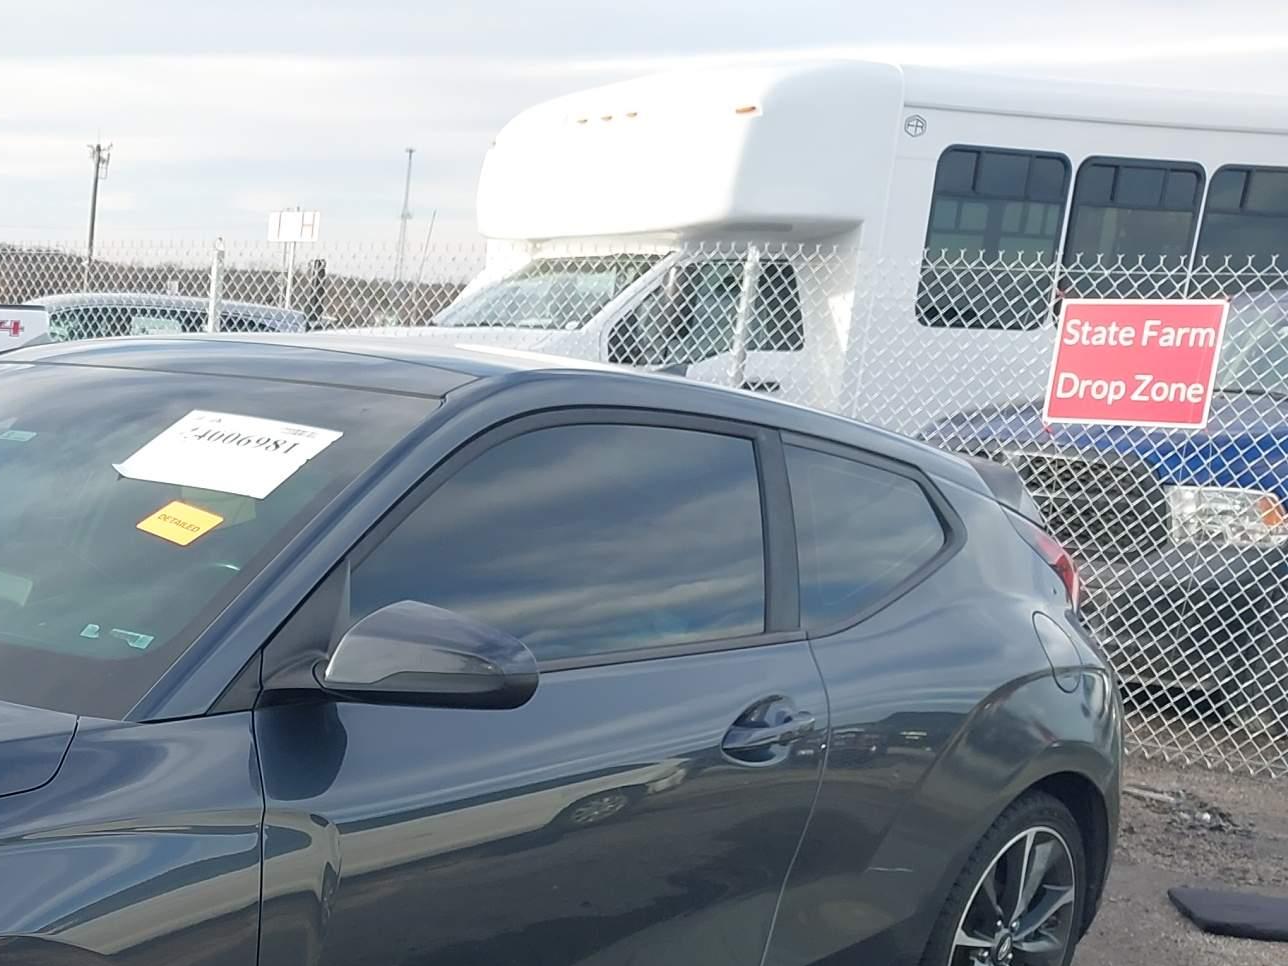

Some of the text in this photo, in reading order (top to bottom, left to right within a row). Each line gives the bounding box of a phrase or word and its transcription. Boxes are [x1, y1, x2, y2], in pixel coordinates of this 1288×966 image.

[1063, 319, 1216, 348] State Farm
[1055, 372, 1206, 405] Drop Zone
[158, 513, 201, 533] DETAILED
